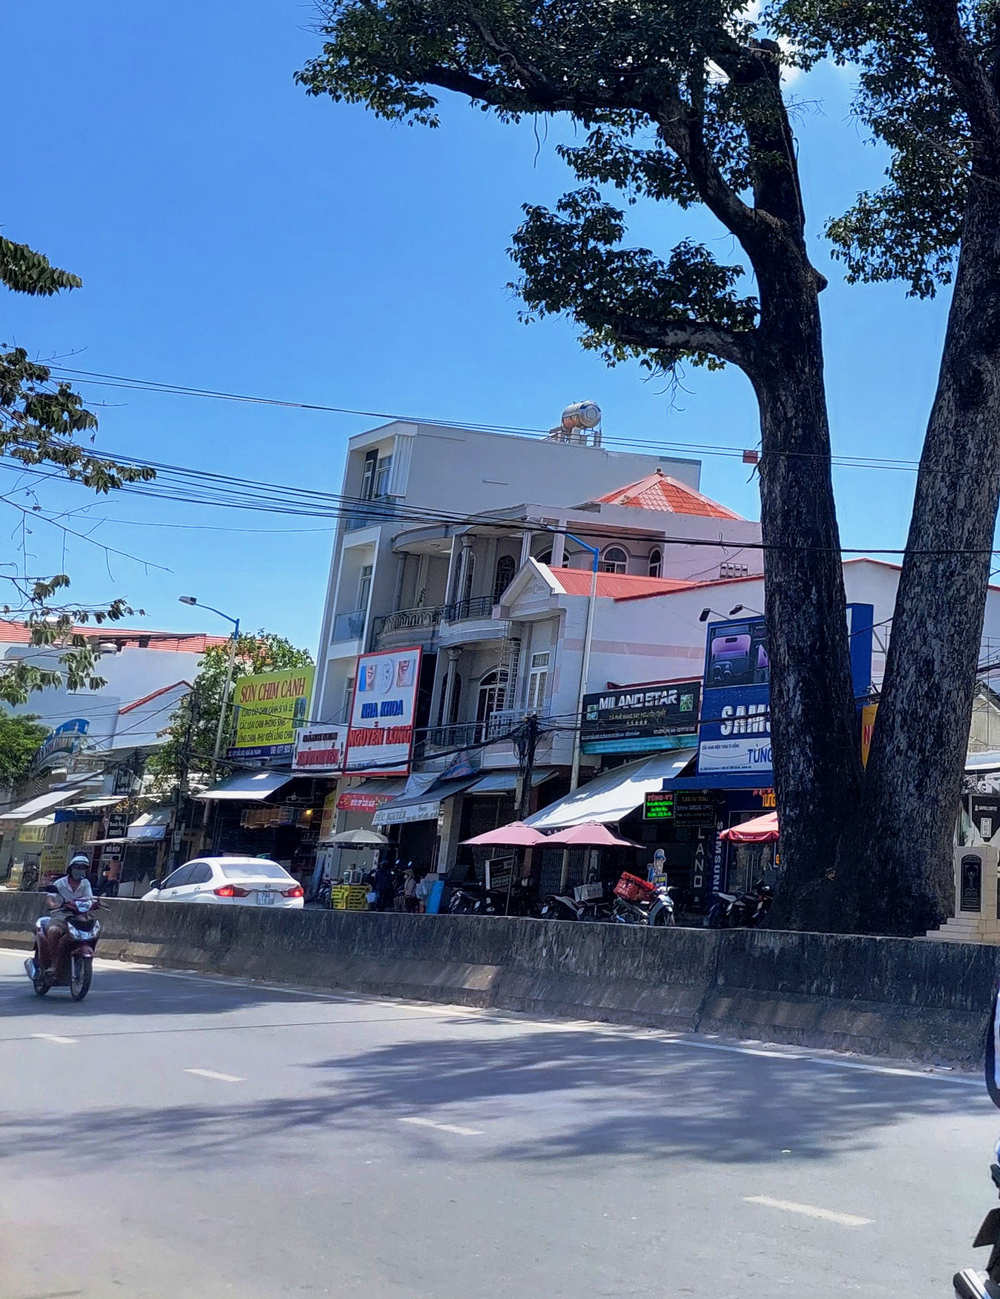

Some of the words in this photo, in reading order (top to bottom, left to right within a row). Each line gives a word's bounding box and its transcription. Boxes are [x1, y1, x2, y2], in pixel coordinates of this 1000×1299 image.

[258, 681, 280, 701] CHIM
[281, 672, 306, 698] CẢNH
[645, 690, 677, 706] STAR
[361, 702, 378, 719] NHA
[380, 700, 403, 716] KHOA
[385, 725, 411, 745] LONG
